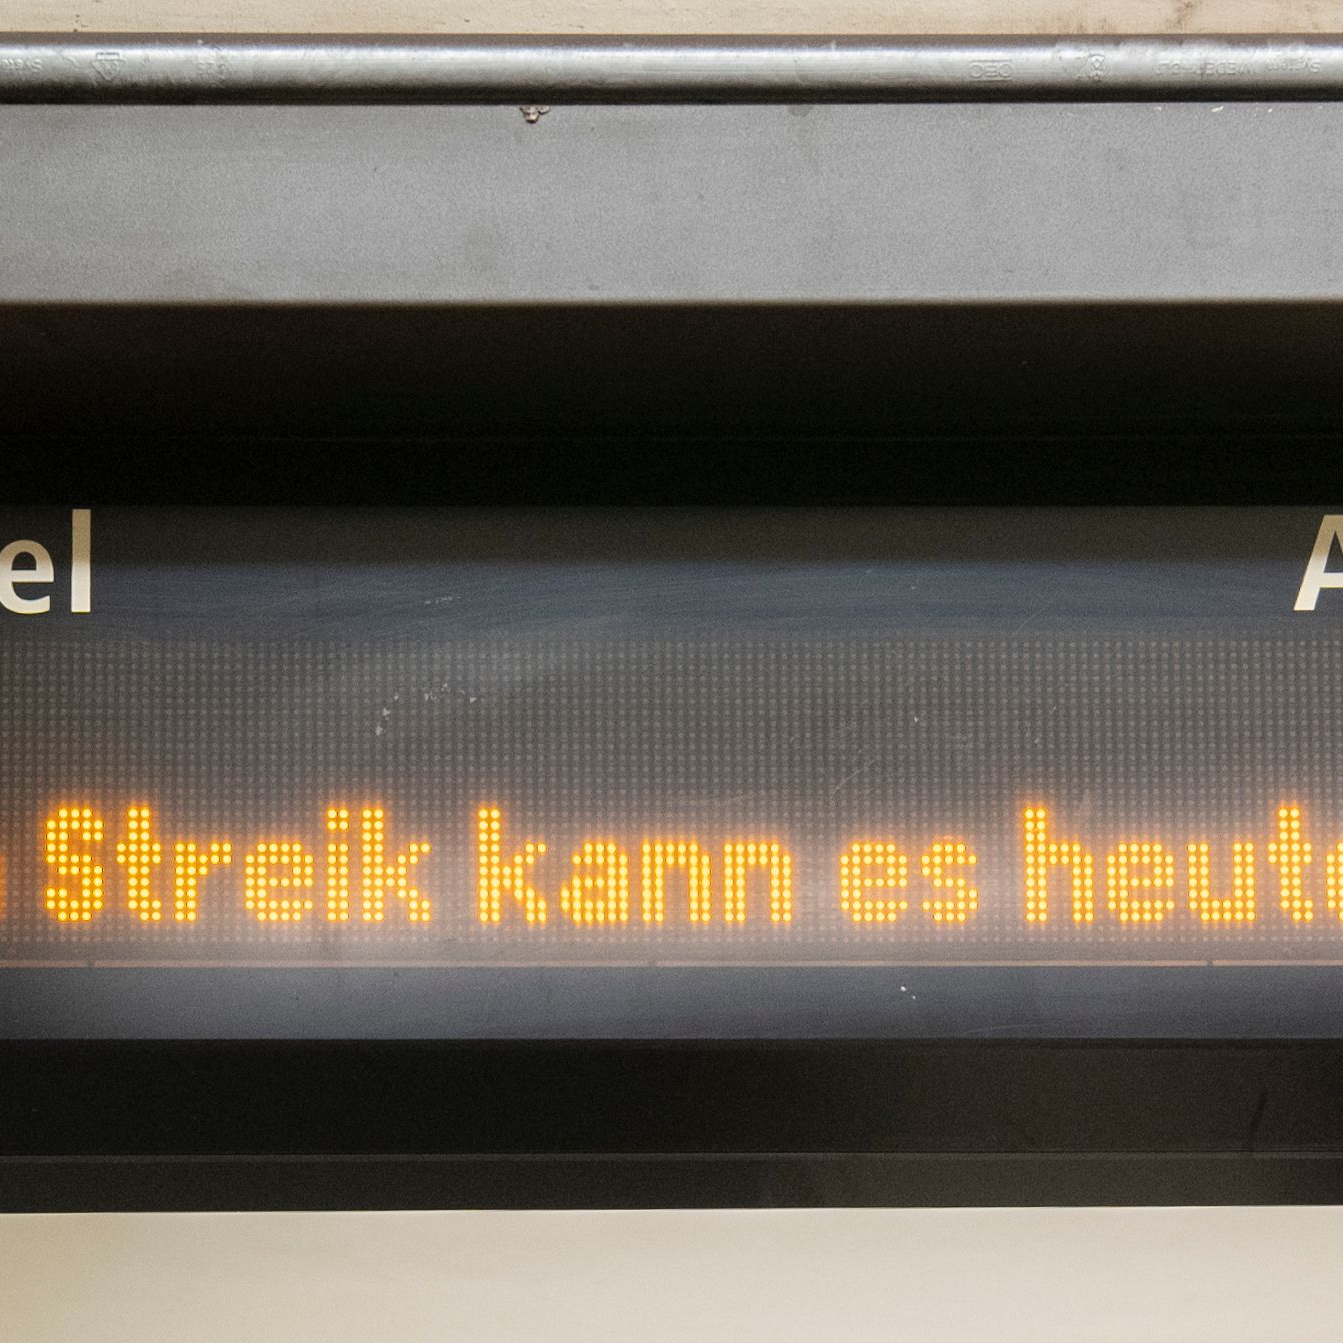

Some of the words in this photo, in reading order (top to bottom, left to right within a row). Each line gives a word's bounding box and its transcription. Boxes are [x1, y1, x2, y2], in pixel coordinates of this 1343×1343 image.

[43, 802, 434, 926] Streik
[473, 804, 797, 926] kann
[836, 838, 982, 926] es
